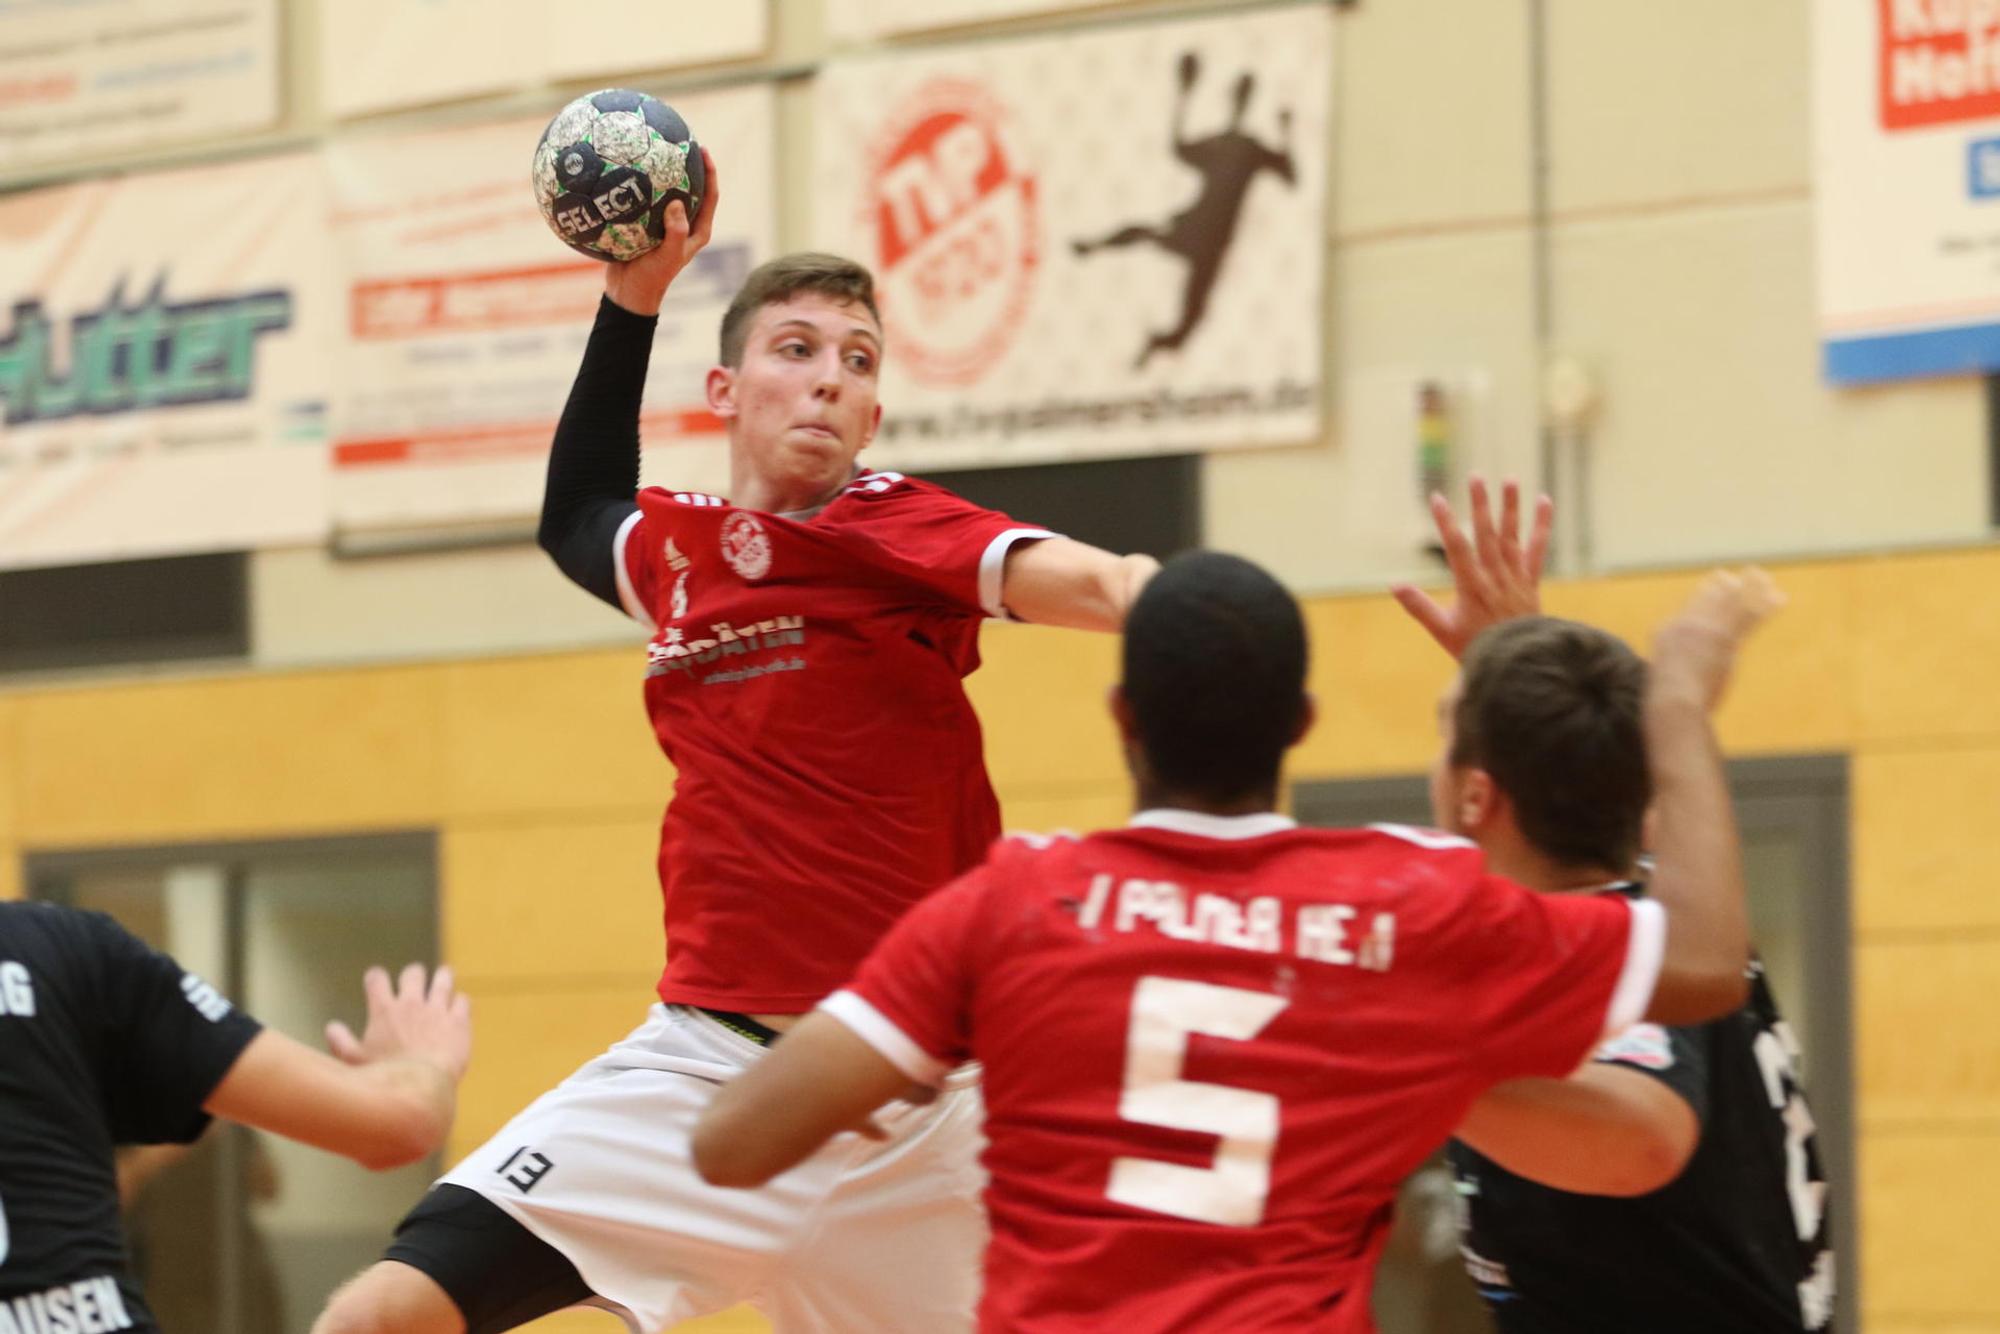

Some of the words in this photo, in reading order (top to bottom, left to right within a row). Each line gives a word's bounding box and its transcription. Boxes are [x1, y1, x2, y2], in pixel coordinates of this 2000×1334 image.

[556, 175, 647, 237] SELECT
[1105, 974, 1292, 1228] 5
[496, 1145, 555, 1194] 13
